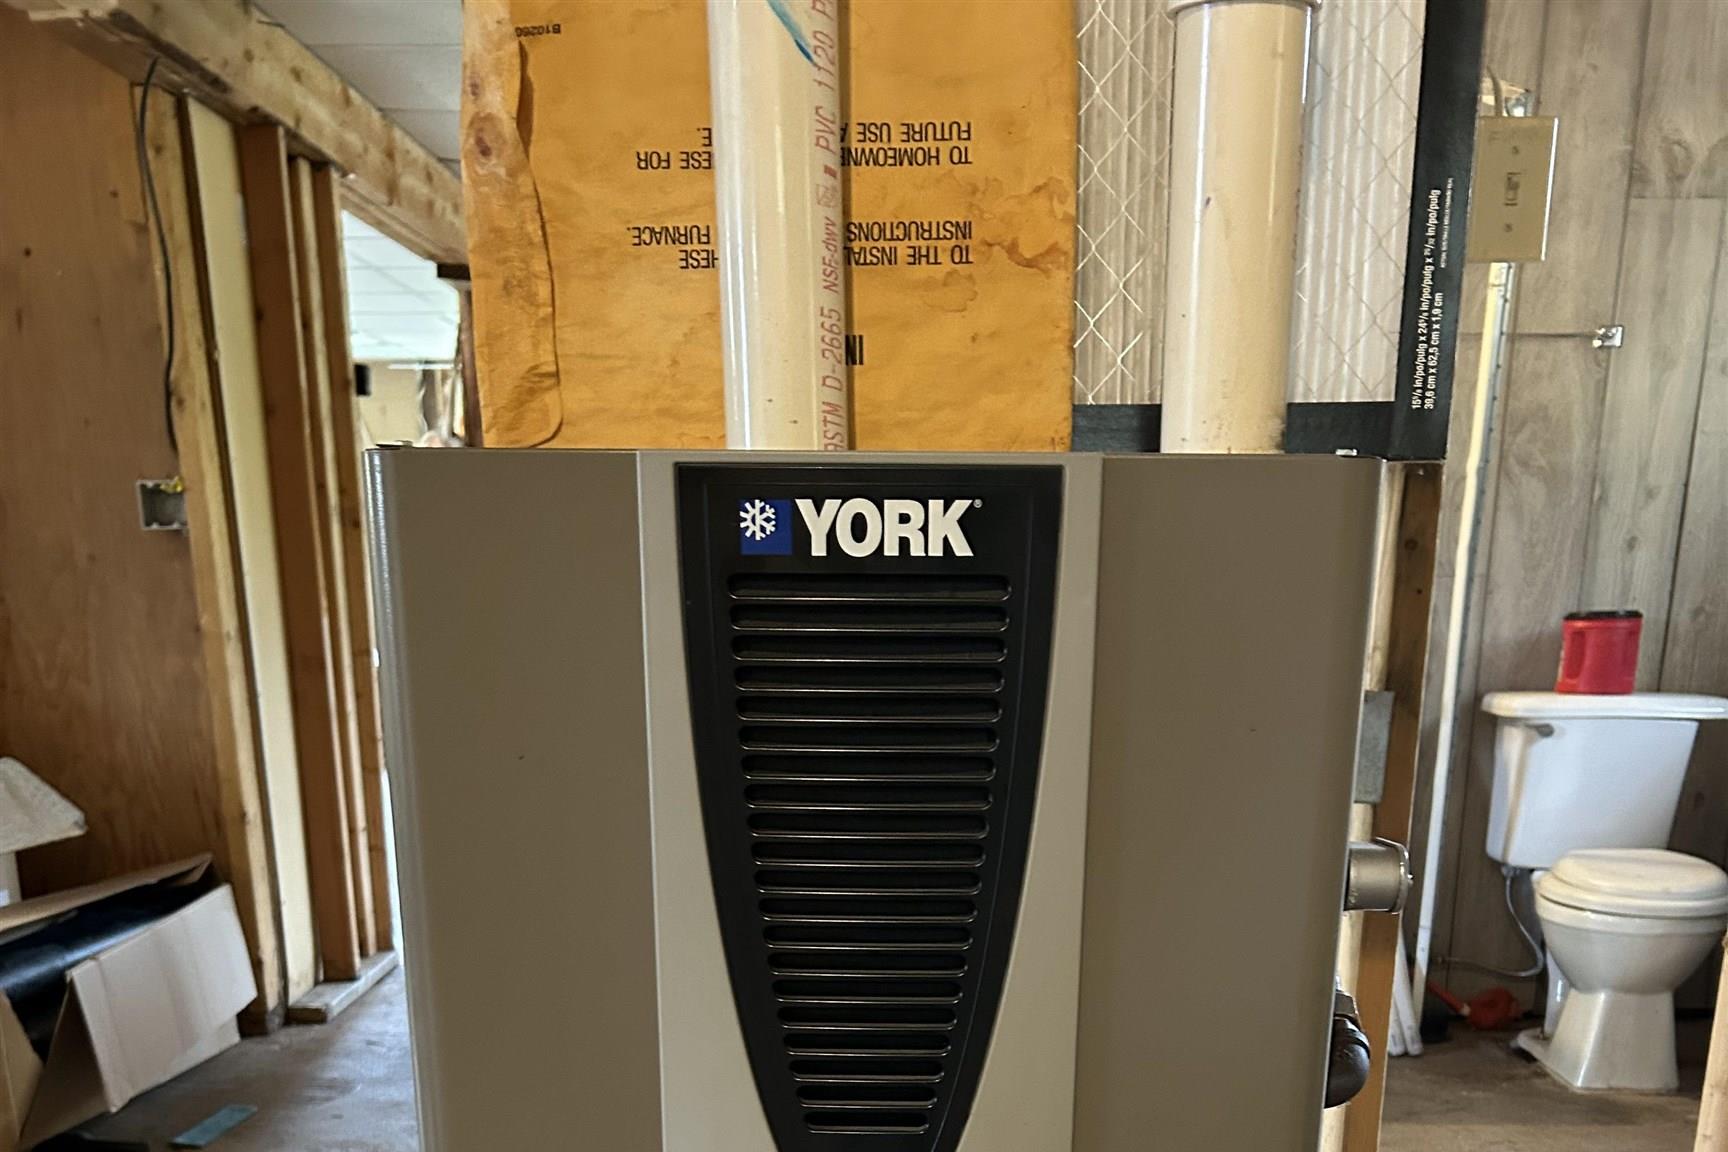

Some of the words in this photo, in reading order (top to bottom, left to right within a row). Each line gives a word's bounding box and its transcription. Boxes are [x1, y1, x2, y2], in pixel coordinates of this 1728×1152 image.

[812, 30, 836, 90] 1120
[697, 127, 713, 147] E.
[815, 105, 837, 155] PVC
[840, 122, 849, 143] A
[856, 122, 891, 143] USE
[901, 121, 971, 143] FUTURE
[636, 151, 671, 170] FOR
[680, 151, 712, 170] ESE
[840, 146, 941, 167] HOMEOWNE
[949, 146, 973, 165] TO
[627, 225, 711, 246] FURNACE.
[847, 220, 972, 242] INSTRUCTIONS
[678, 249, 719, 269] HESE
[843, 245, 897, 266] INSTAL
[906, 245, 942, 265] THE
[951, 244, 974, 265] TO
[1434, 292, 1444, 307] cm
[820, 306, 843, 391] D-2665
[1431, 331, 1440, 345] cm
[845, 334, 864, 366] IN
[1427, 375, 1437, 389] cm
[795, 498, 974, 557] YORK
